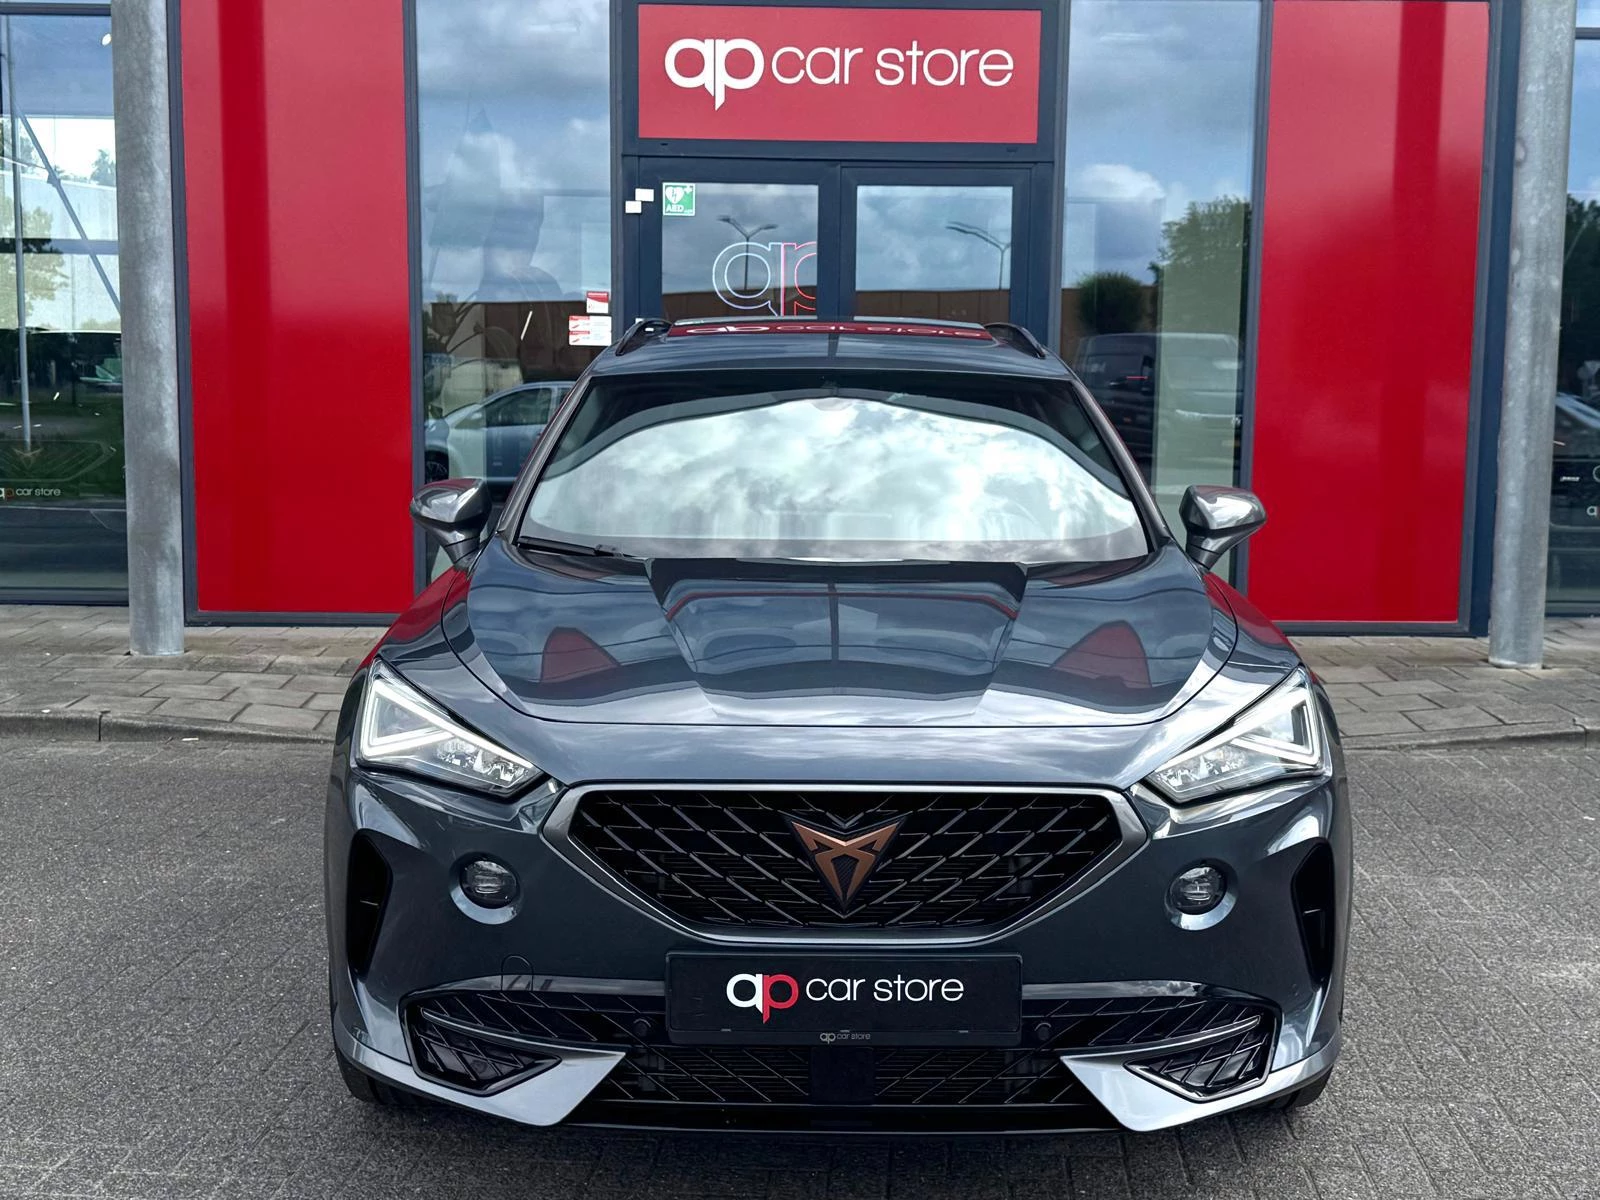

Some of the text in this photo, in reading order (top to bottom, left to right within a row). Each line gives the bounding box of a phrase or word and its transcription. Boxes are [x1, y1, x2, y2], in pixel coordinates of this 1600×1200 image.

[664, 38, 1014, 111] ap car store
[665, 204, 685, 213] AED
[15, 488, 33, 496] car
[726, 973, 965, 1024] ap car store
[820, 1033, 836, 1045] ap
